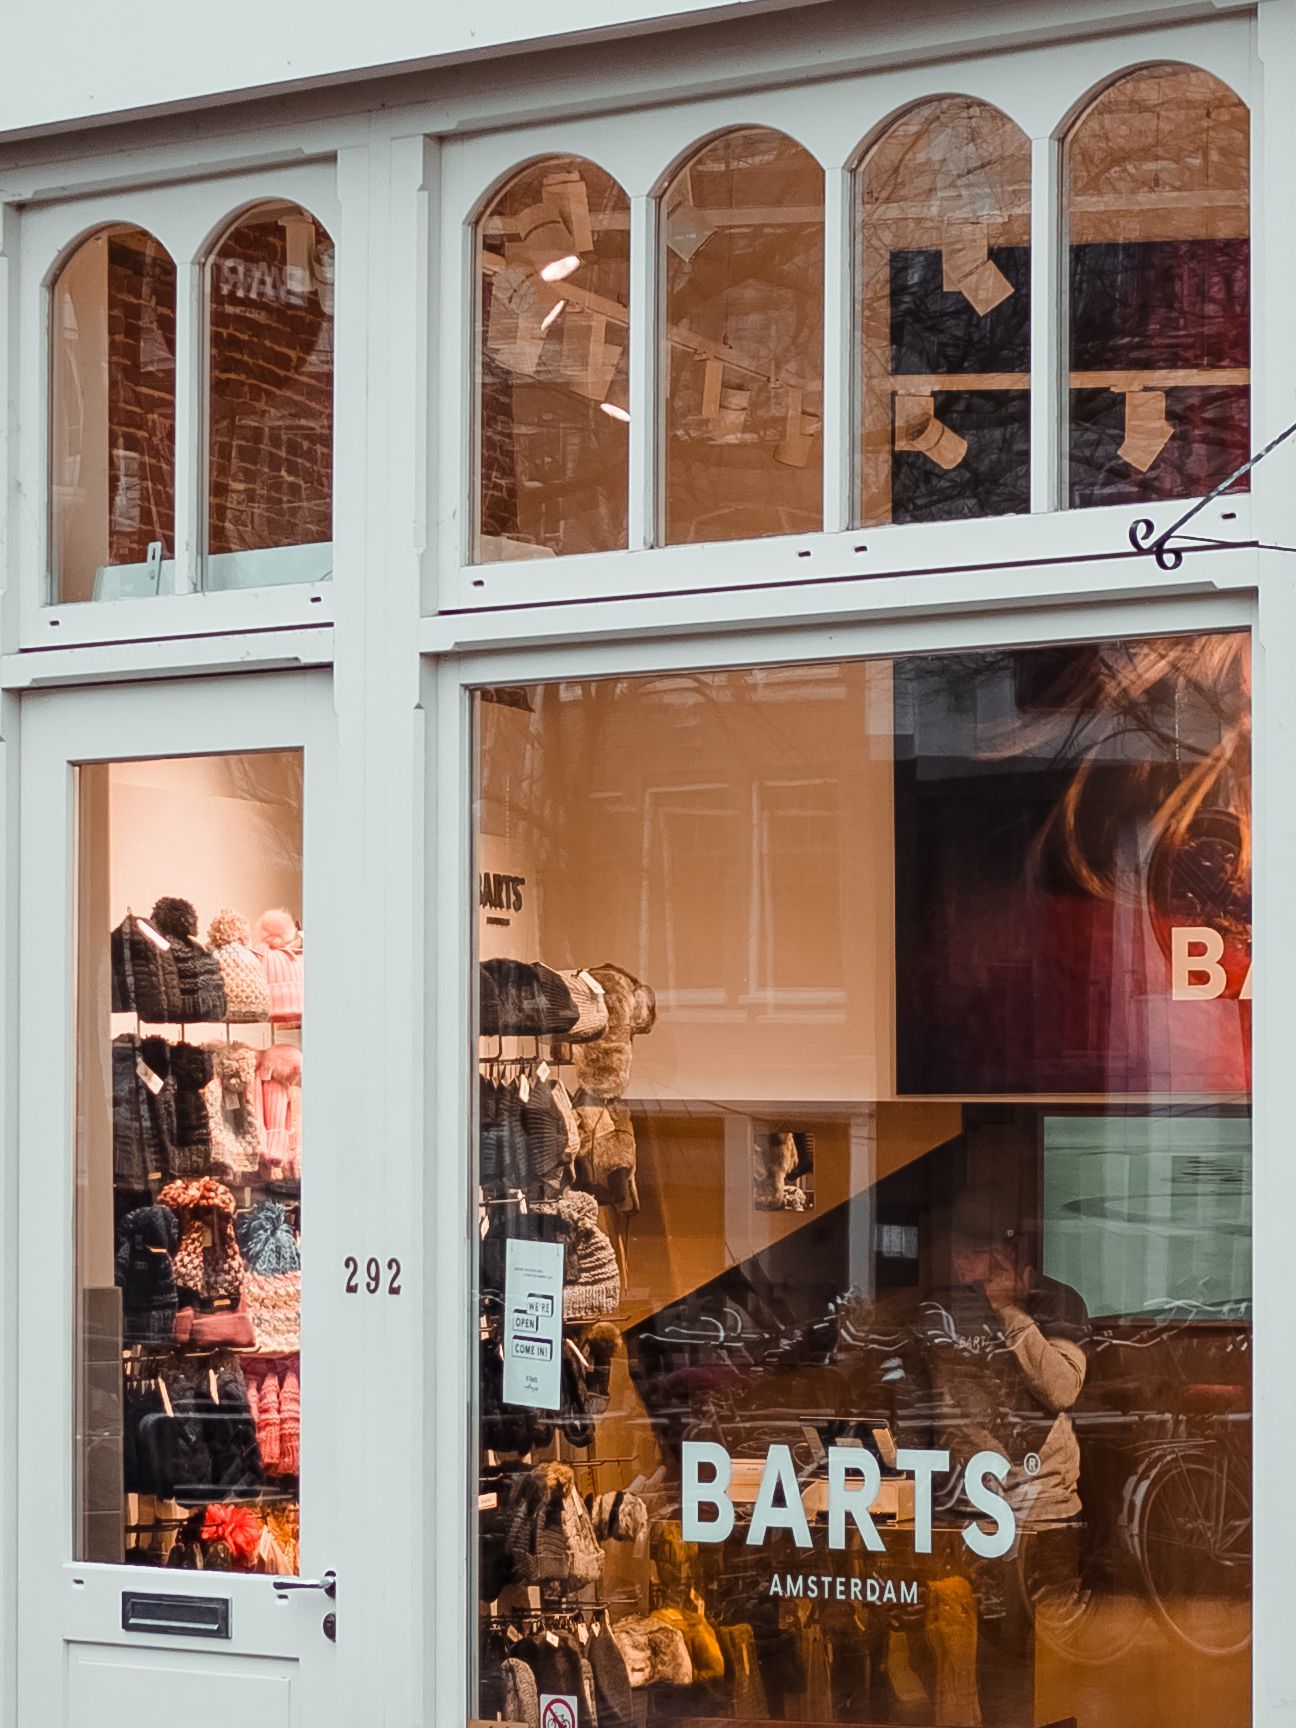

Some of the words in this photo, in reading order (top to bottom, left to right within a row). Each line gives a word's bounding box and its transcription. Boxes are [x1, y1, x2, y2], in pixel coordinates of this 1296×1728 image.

[344, 1256, 402, 1295] 292
[515, 1317, 535, 1329] OPEN
[514, 1343, 535, 1356] COME
[769, 1573, 919, 1605] AMSTERDAM
